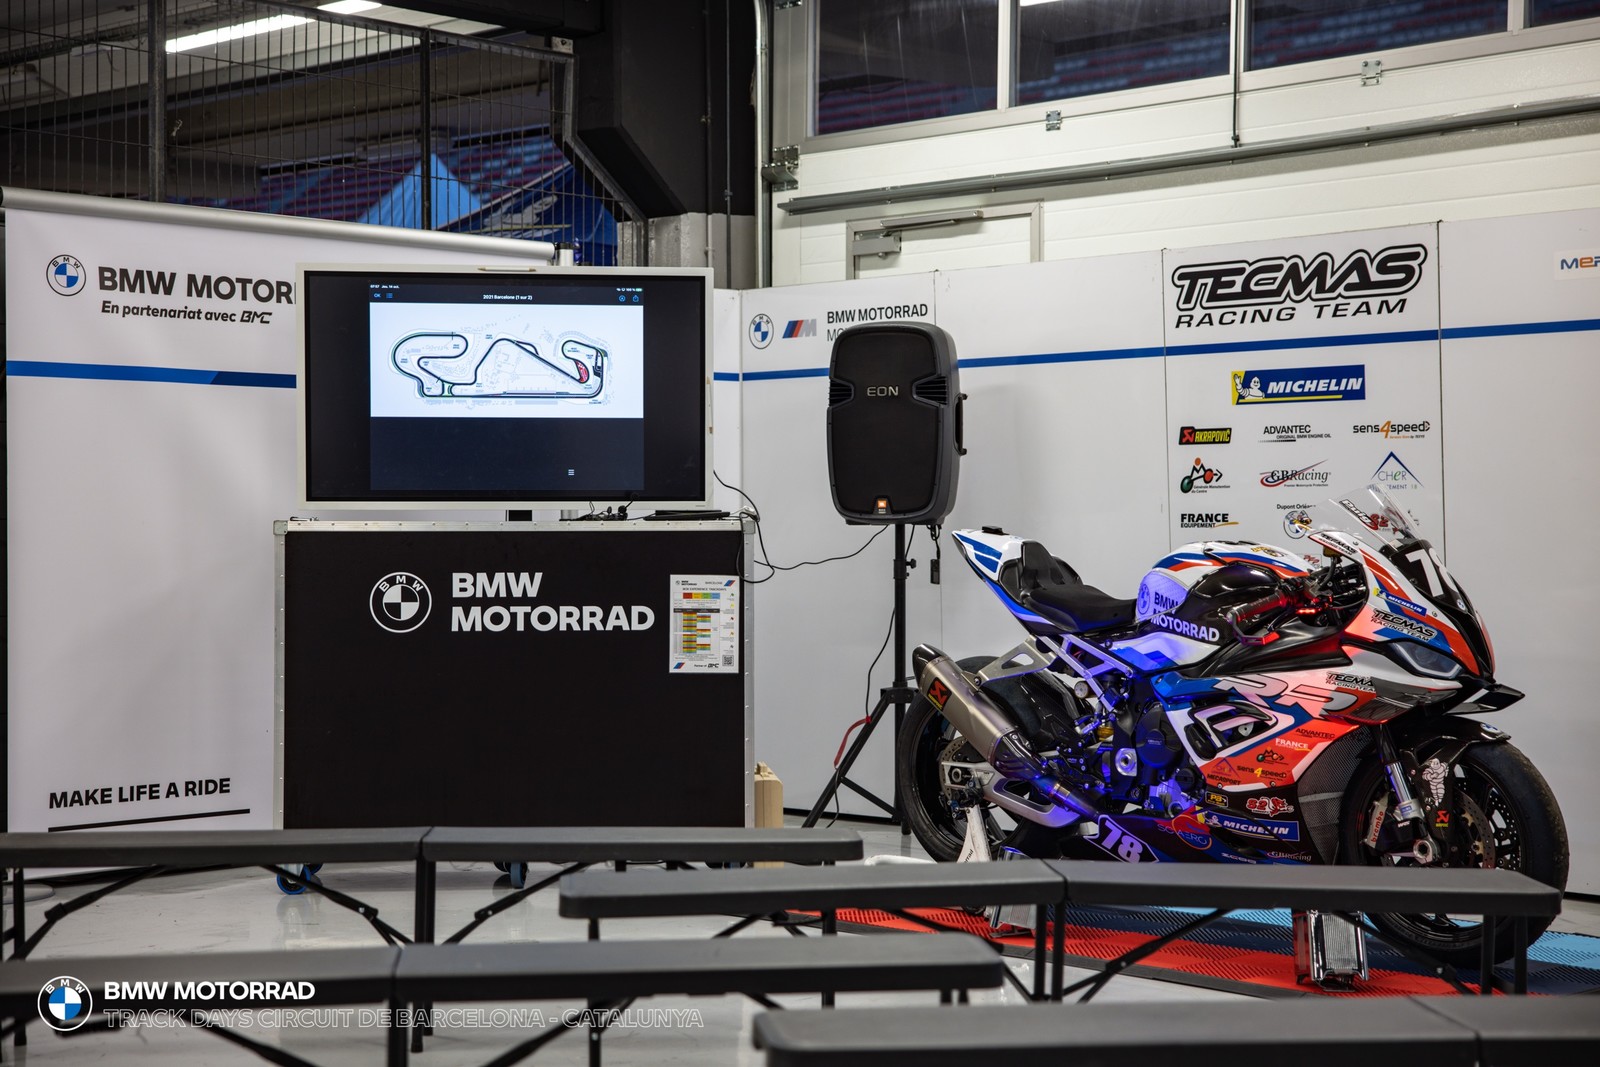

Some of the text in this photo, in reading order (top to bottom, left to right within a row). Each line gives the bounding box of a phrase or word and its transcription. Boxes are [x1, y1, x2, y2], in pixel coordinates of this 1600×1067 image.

[51, 257, 81, 269] BMW
[98, 266, 296, 305] BMW MOTOR
[1172, 244, 1428, 311] TECMAS
[101, 301, 272, 324] En partenariat avec BMC
[827, 303, 928, 324] BMW MOTORRAD
[1175, 299, 1407, 329] RACING TEAM
[867, 386, 898, 396] EON
[1267, 378, 1363, 394] MICHELIN
[1263, 425, 1311, 434] ADVANTEC
[1353, 420, 1427, 438] sens4speed
[1181, 514, 1229, 522] FRANCE
[379, 574, 424, 592] BMW
[452, 572, 543, 598] BMW
[1388, 595, 1423, 613] MICHELIN
[451, 605, 655, 632] MOTORRAD
[1150, 608, 1220, 642] MOTORRAD
[1371, 618, 1429, 641] RACING TEAM
[1373, 608, 1437, 638] TECMAS
[1326, 672, 1375, 687] TECMA
[1275, 737, 1309, 748] FRANCE
[1295, 728, 1336, 739] ADVANTEC
[49, 778, 230, 808] MAKE LIFE A RIDE
[1371, 811, 1384, 842] brembo
[1101, 820, 1143, 862] 78
